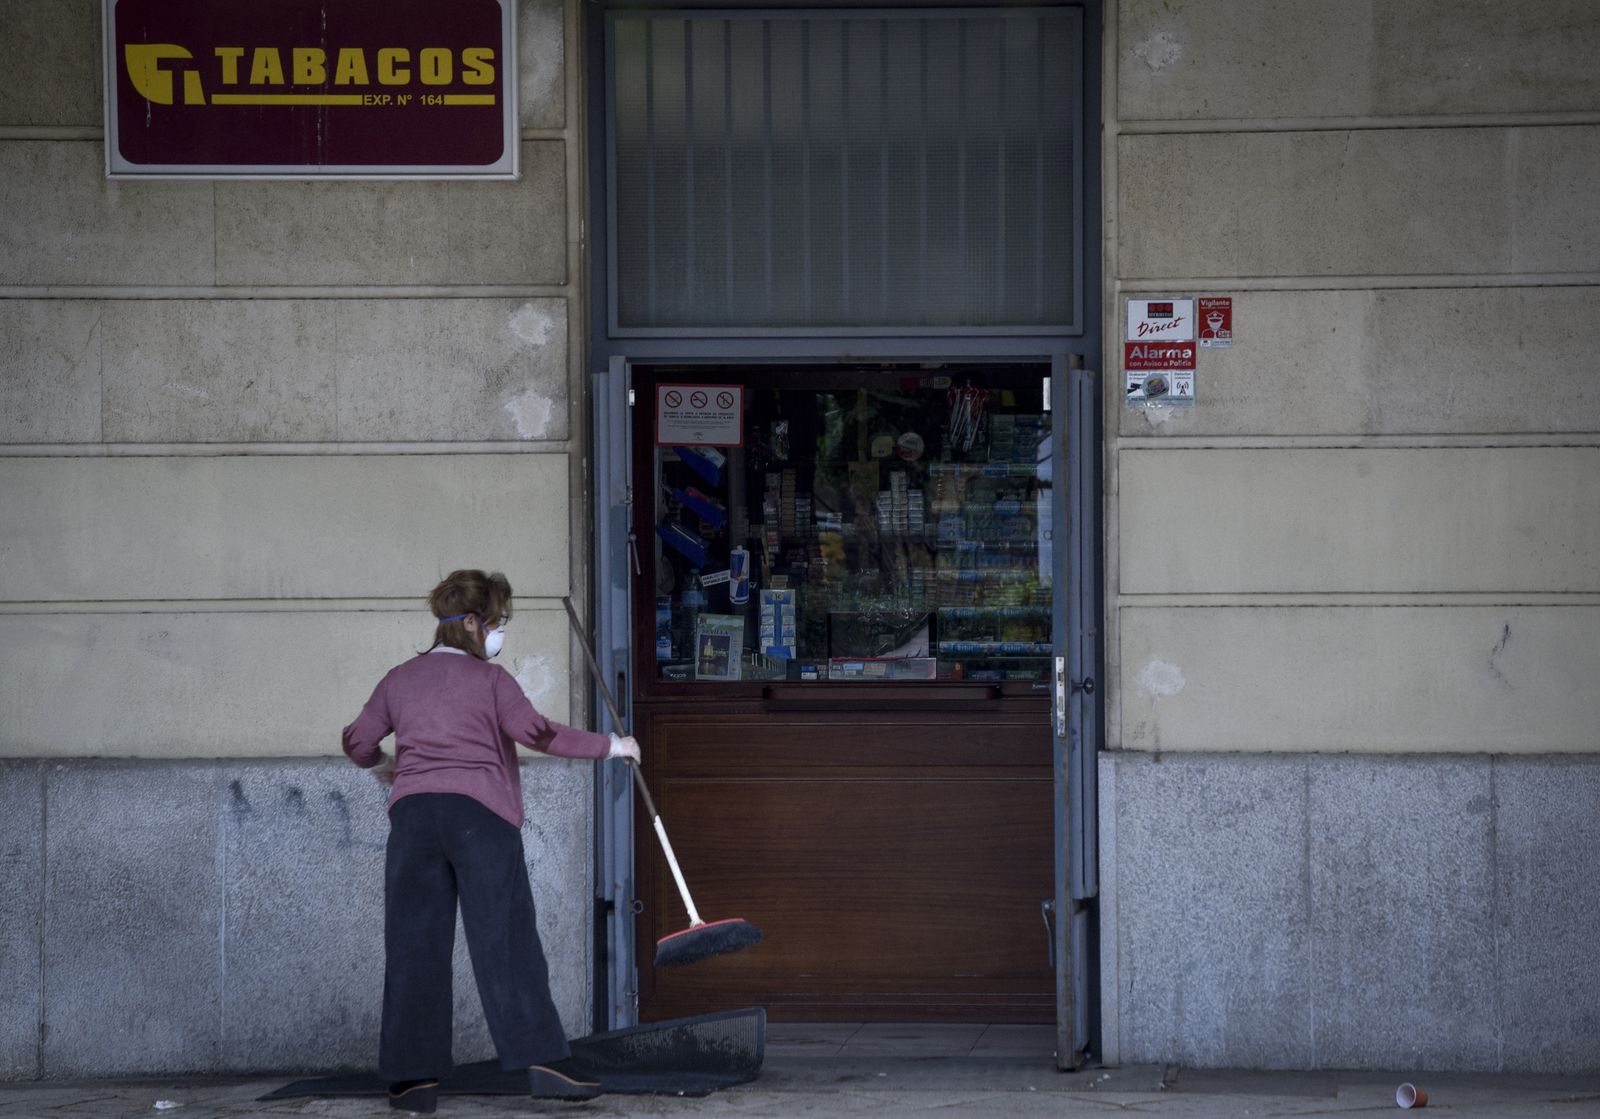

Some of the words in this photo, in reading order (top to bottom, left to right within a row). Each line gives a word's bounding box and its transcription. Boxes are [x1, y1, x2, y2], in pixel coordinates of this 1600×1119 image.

[214, 47, 496, 86] TABACOS
[363, 94, 394, 106] EXP.
[419, 94, 443, 106] 164
[1200, 299, 1230, 307] Vigilante
[1137, 316, 1186, 337] Direct
[1129, 345, 1192, 359] Alarma
